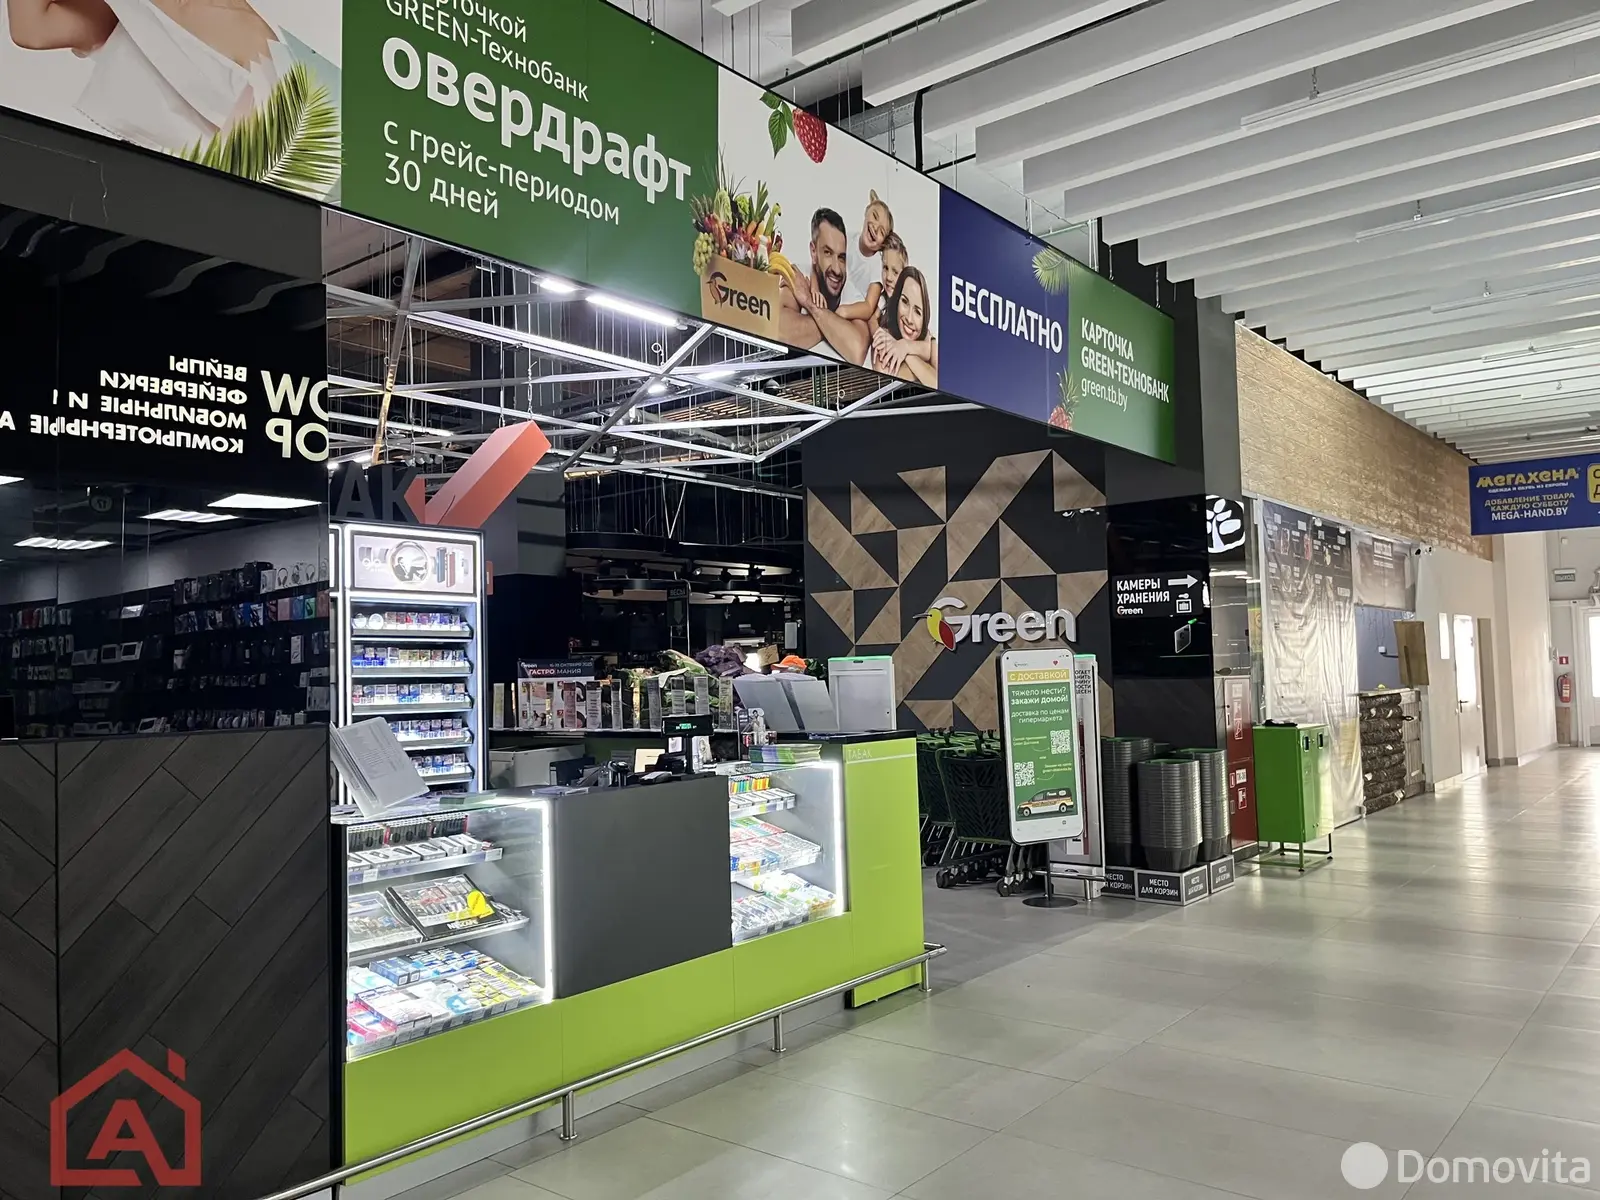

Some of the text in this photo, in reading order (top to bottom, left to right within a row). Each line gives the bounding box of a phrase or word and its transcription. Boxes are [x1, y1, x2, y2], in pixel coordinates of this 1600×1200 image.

[382, 36, 692, 205] овердрафт
[383, 119, 620, 226] с грейс-периодом
[385, 153, 499, 219] 30 дней
[706, 271, 771, 321] Green
[950, 275, 1063, 353] БЕСПЛАТНО
[1081, 317, 1134, 362] КАРТОЧКА
[1081, 345, 1170, 404] GREEN-ТЕХНОБАНК
[1081, 377, 1129, 412] green.tb.by
[1484, 492, 1576, 507] ДОБАВЛЕНИЕ ТОВАРА
[1491, 500, 1569, 512] КАЖДУЮ СУББОТУ
[1492, 507, 1568, 520] MEGA-HAND.BY
[1116, 578, 1160, 591] КАМЕРЫ
[1116, 591, 1170, 604] ХРАНЕНИЯ
[1116, 605, 1144, 615] Green
[920, 597, 1077, 651] Green
[1017, 669, 1067, 682] доставкой
[1011, 686, 1067, 698] тяжело нести?
[1010, 694, 1069, 705] закажи домой!
[1011, 710, 1039, 718] доставка
[1049, 708, 1069, 716] ценам
[1018, 715, 1063, 724] гипермаркета
[1109, 881, 1133, 890] КОРЗИН
[1149, 878, 1169, 887] МЕСТО
[1140, 886, 1179, 897] ДЛЯ КОРЗИН
